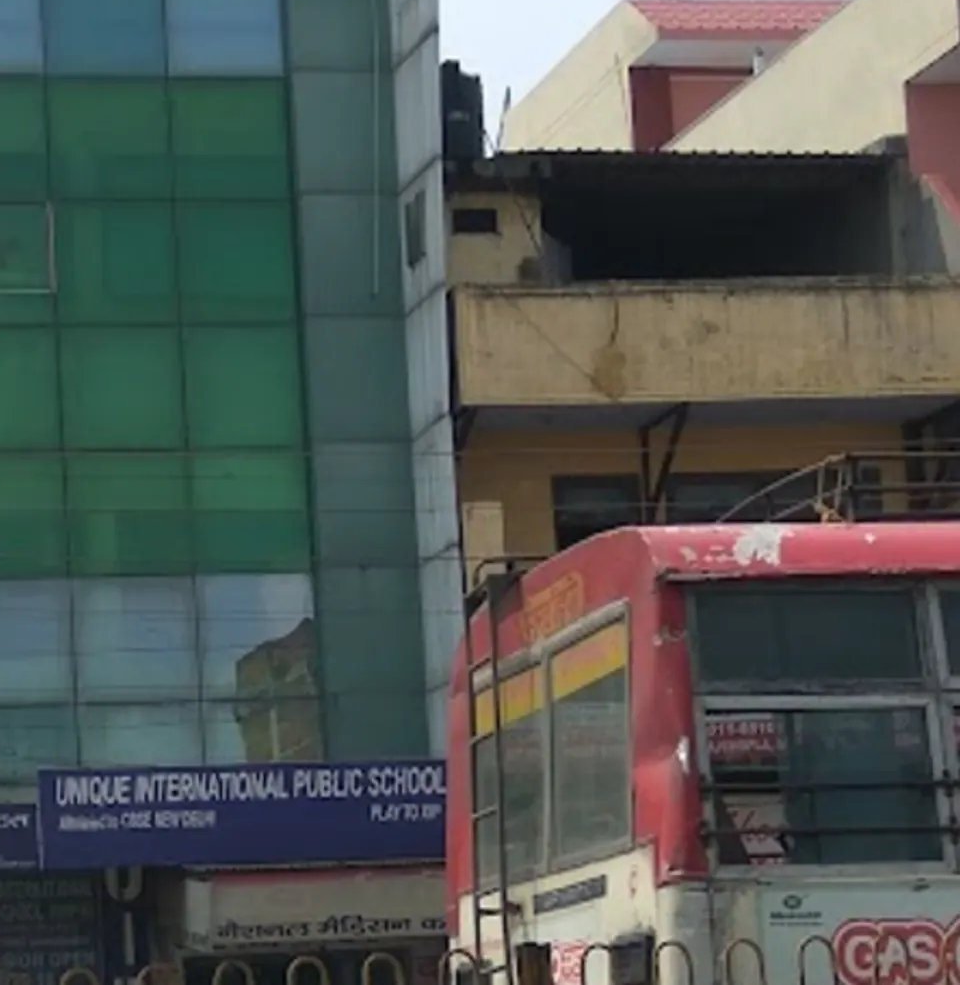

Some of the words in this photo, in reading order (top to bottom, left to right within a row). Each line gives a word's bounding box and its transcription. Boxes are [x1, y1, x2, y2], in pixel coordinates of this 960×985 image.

[55, 776, 131, 806] UNIQUE
[135, 771, 289, 802] INTERNATIONAL
[293, 769, 364, 798] PUBLIC
[367, 766, 447, 796] SCHOOL
